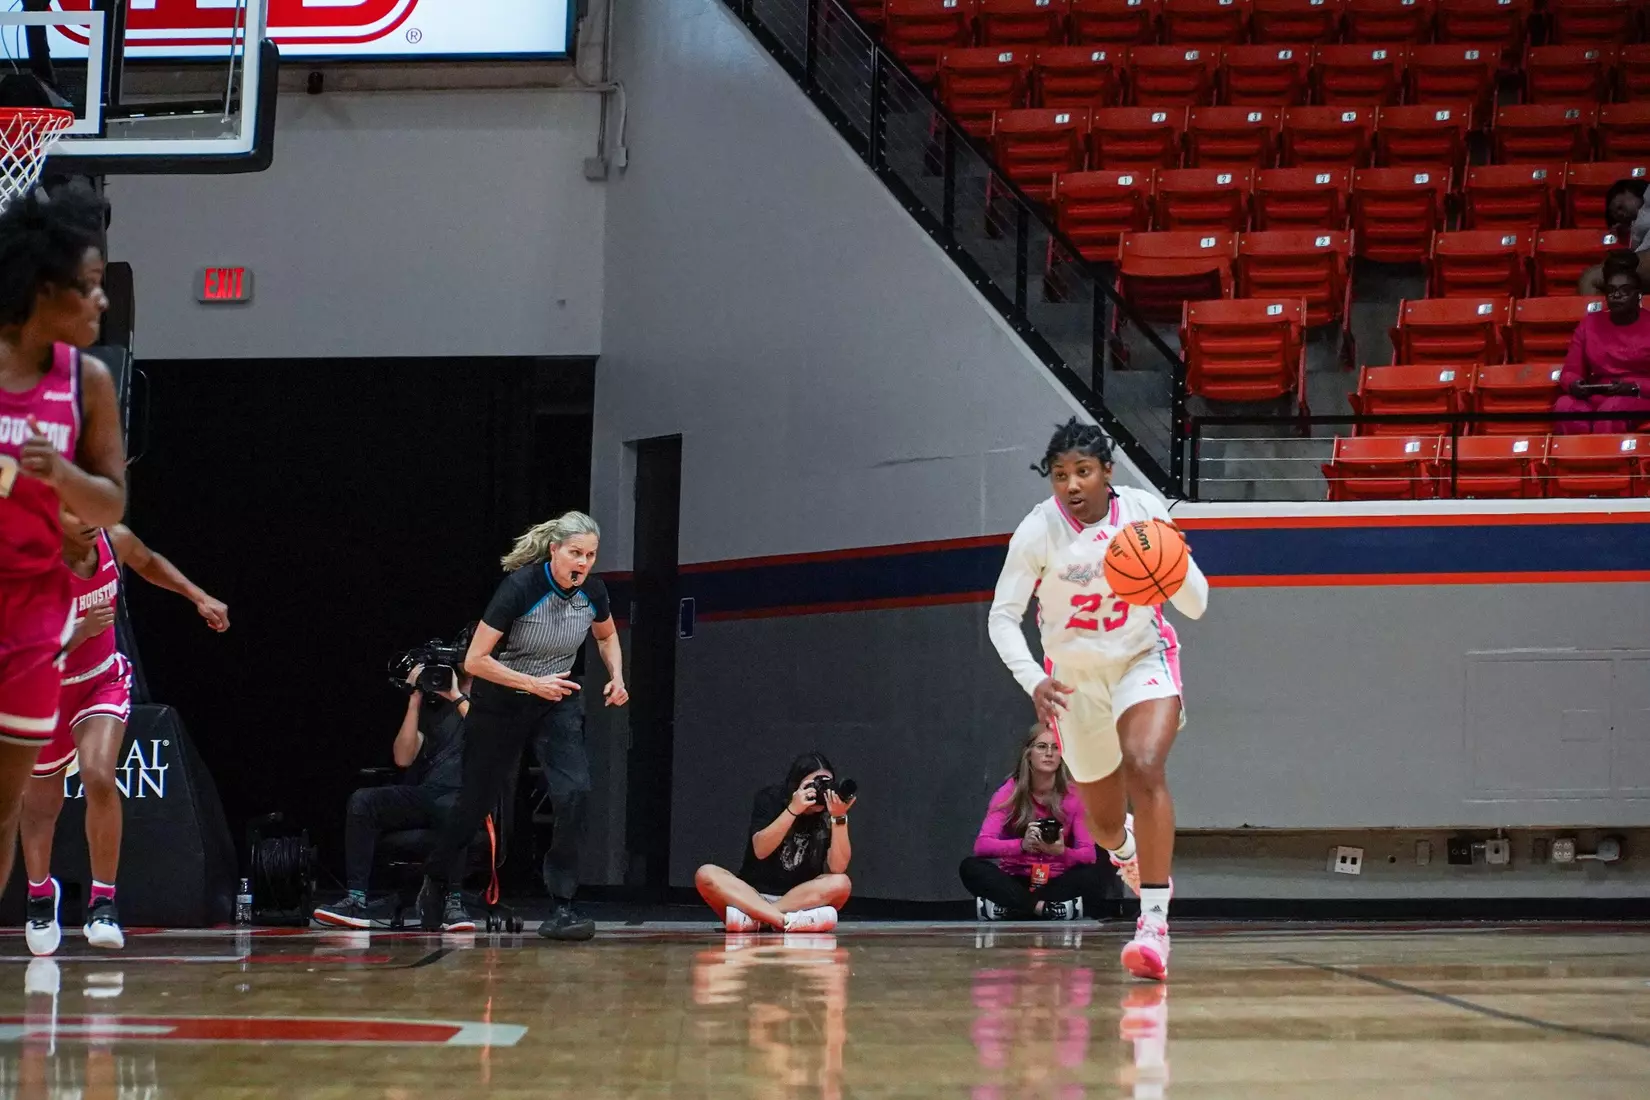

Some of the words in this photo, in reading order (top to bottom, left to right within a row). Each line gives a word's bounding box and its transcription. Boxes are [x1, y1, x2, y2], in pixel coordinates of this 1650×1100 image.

[203, 267, 244, 299] EXIT
[1131, 520, 1151, 553] ilson
[1065, 593, 1129, 632] 23
